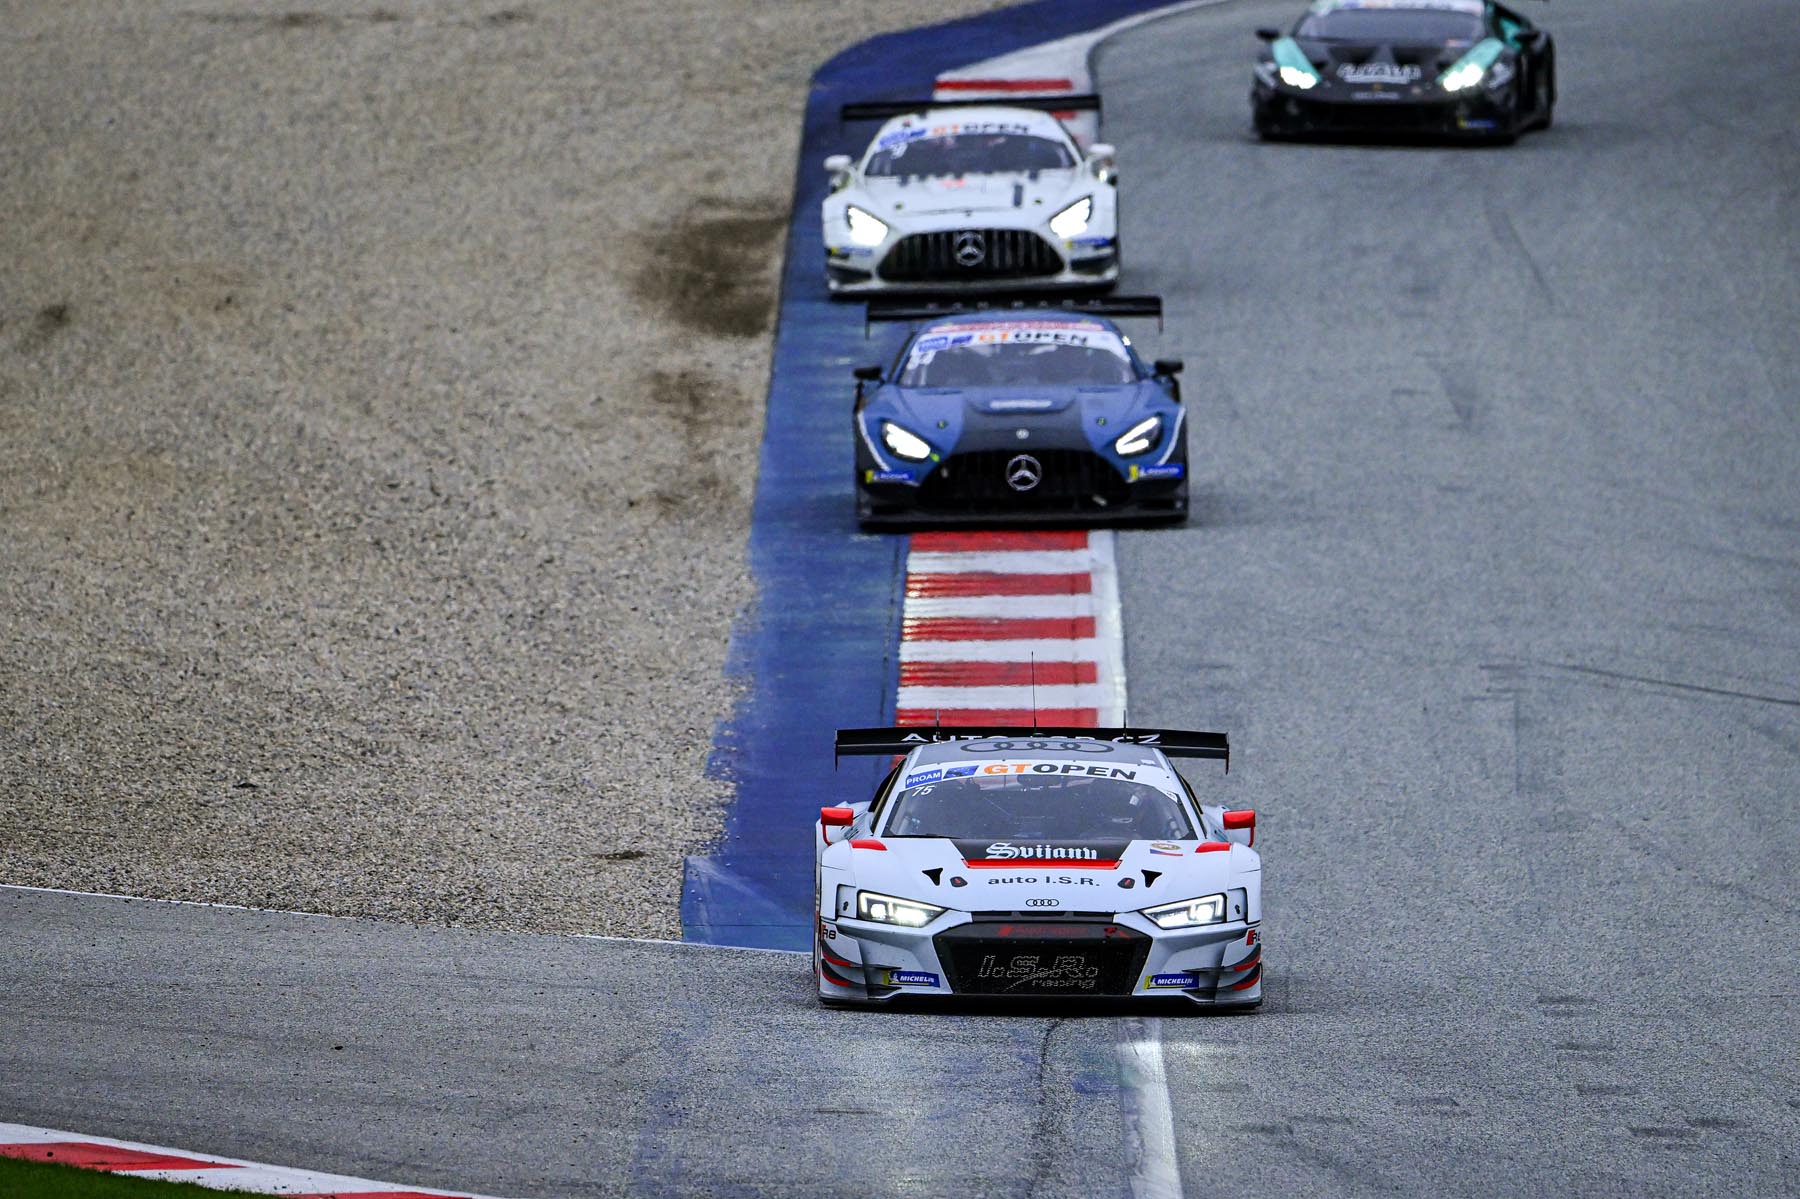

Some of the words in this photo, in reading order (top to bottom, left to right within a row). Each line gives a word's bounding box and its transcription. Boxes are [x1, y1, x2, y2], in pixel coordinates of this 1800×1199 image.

[906, 772, 941, 785] PROAM
[911, 786, 936, 797] 75
[988, 877, 1037, 885] auto
[1046, 876, 1100, 887] I.S.R.
[899, 975, 935, 983] MICHELIN
